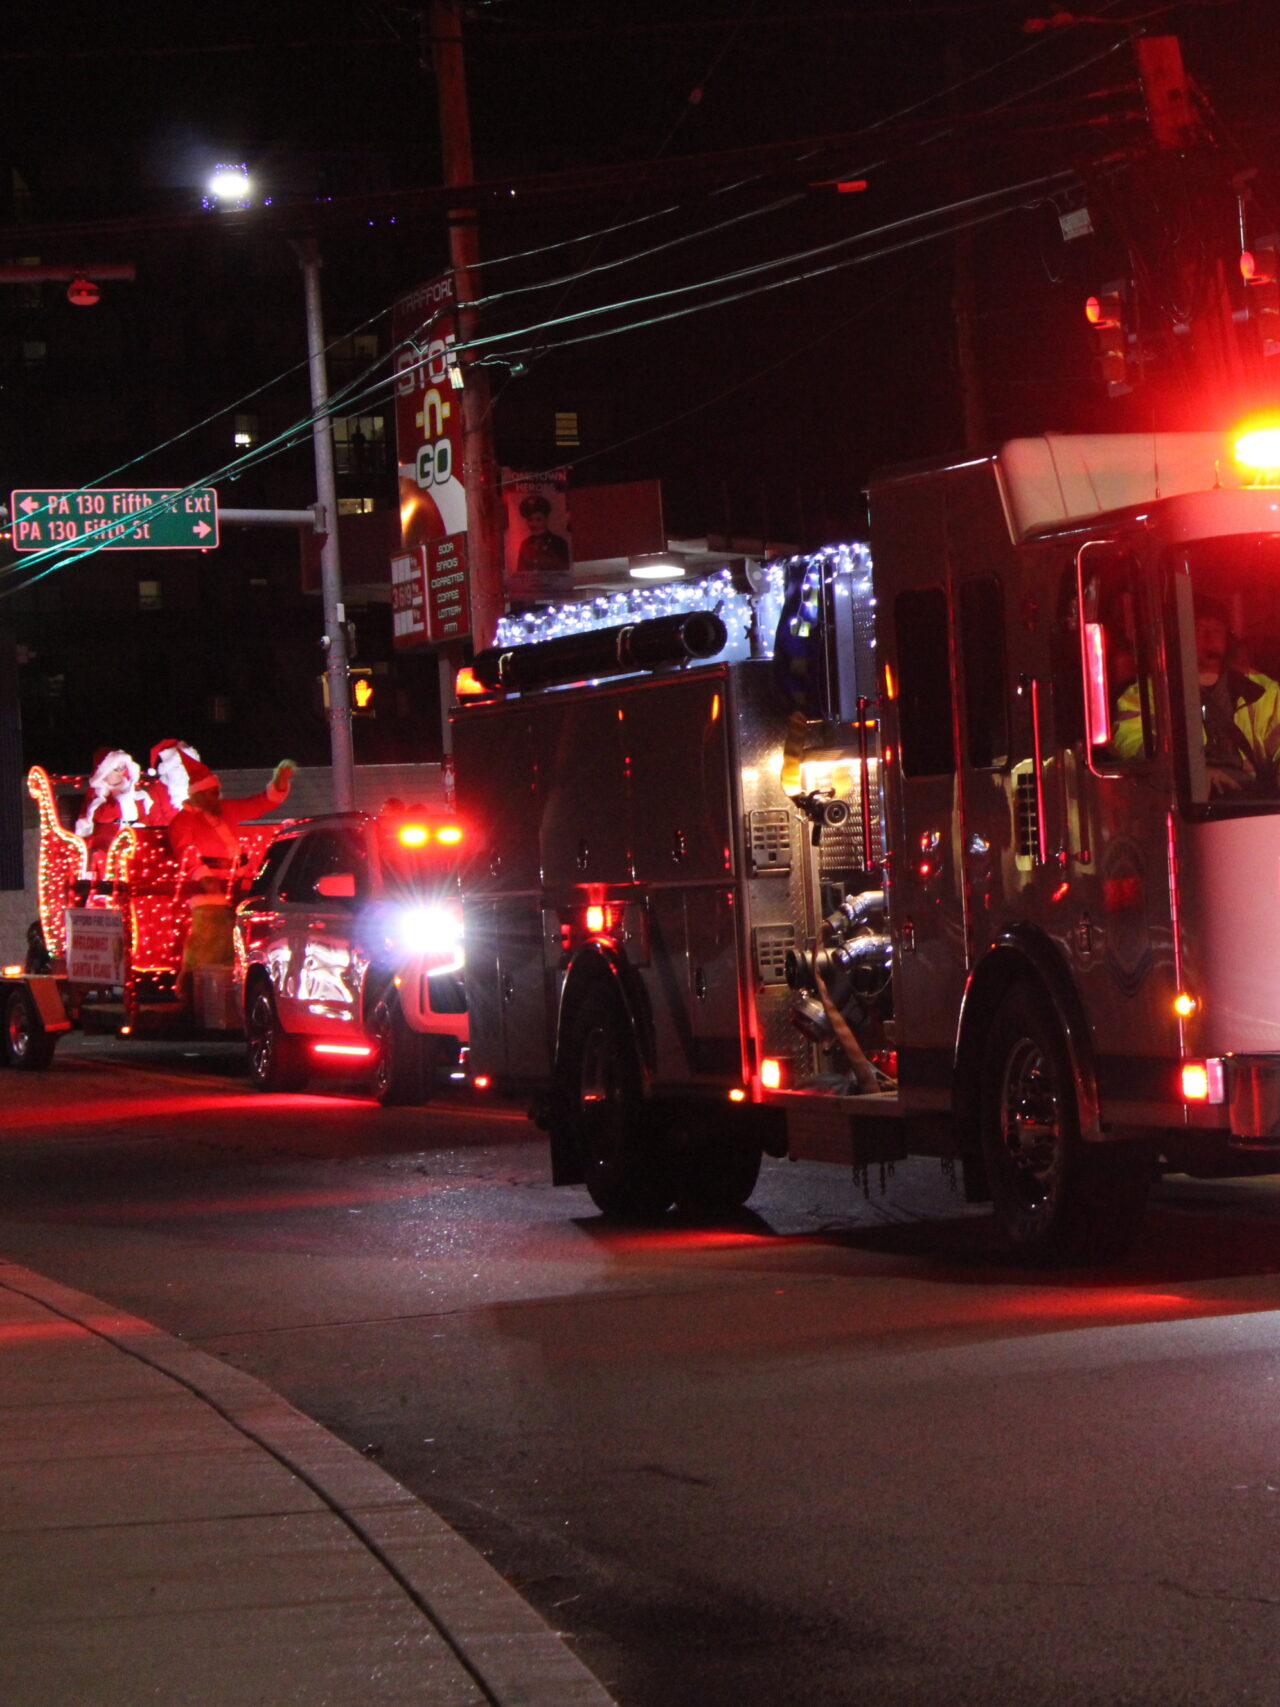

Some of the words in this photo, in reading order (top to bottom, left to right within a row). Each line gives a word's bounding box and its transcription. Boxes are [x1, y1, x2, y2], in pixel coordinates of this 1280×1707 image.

[416, 437, 452, 489] GO
[47, 495, 70, 515] PA
[77, 495, 105, 514] 130
[112, 493, 152, 514] Fifth
[185, 493, 211, 513] Ext
[19, 521, 42, 541] PA
[48, 521, 78, 541] 130
[132, 520, 151, 540] St
